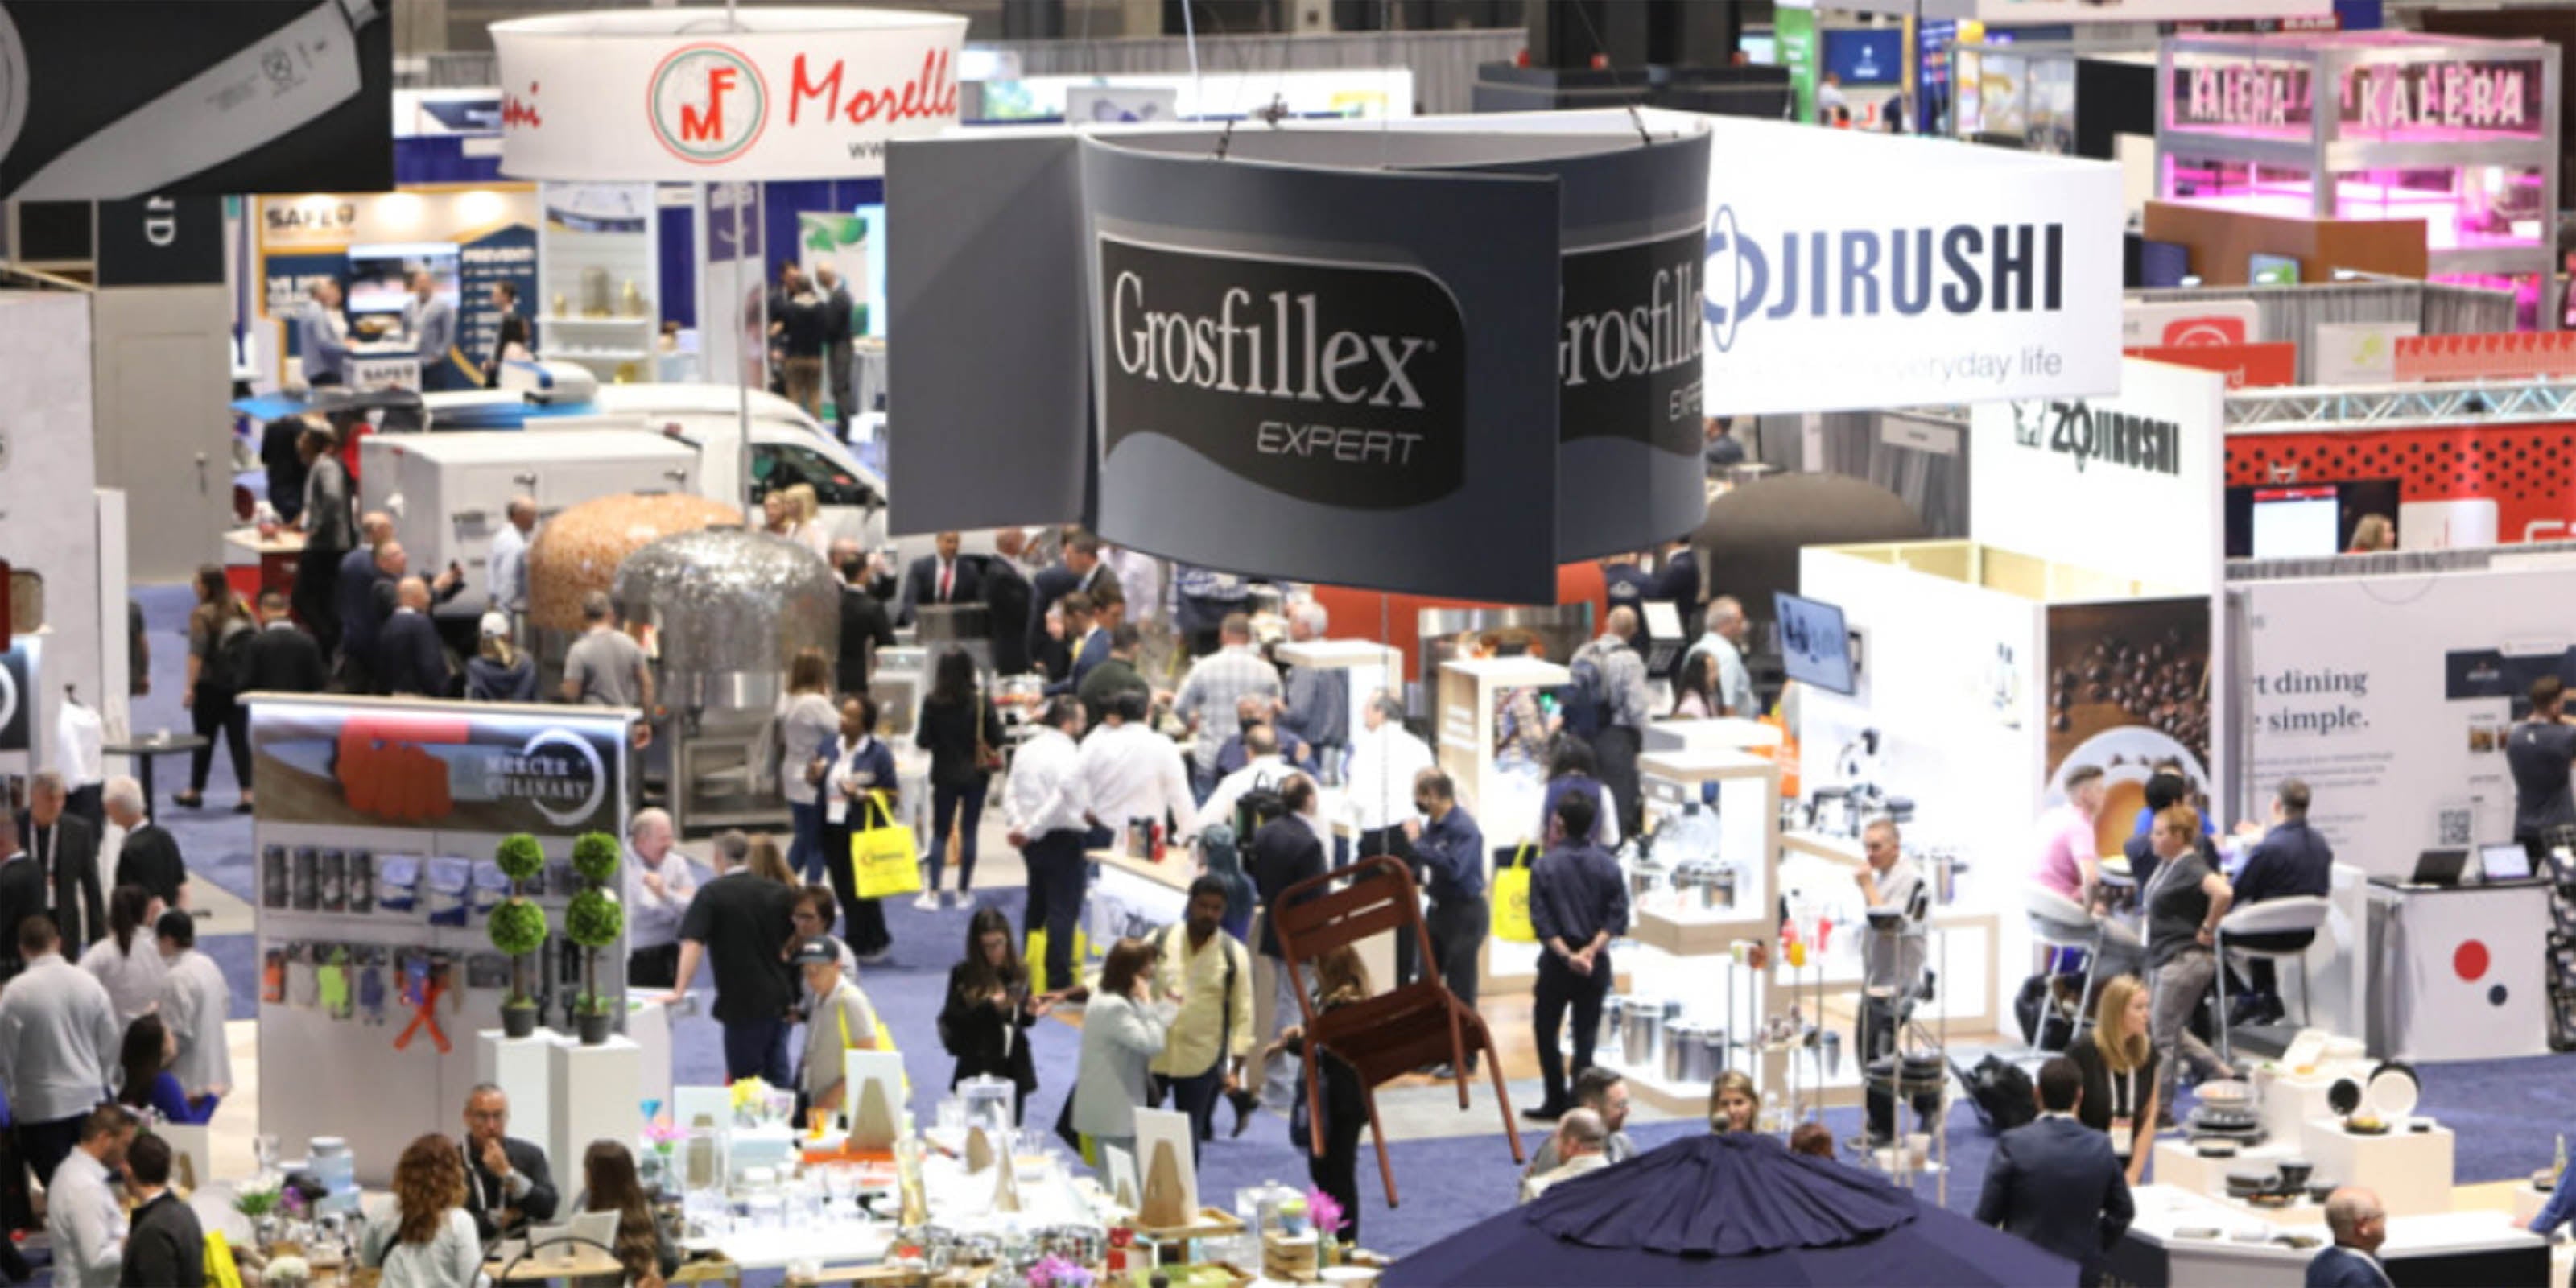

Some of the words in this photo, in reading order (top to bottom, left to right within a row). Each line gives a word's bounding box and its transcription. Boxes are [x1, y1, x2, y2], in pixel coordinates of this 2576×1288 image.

[2361, 72, 2524, 127] KALERA
[1114, 270, 1426, 411] Grosfillex
[2021, 347, 2063, 377] life
[1257, 421, 1423, 464] EXPERT
[2050, 397, 2179, 474] ZOJIRUSHI
[2274, 668, 2368, 698] dining
[2268, 704, 2369, 737] simple.
[485, 755, 569, 776] MERCER
[485, 777, 590, 799] CULINARY
